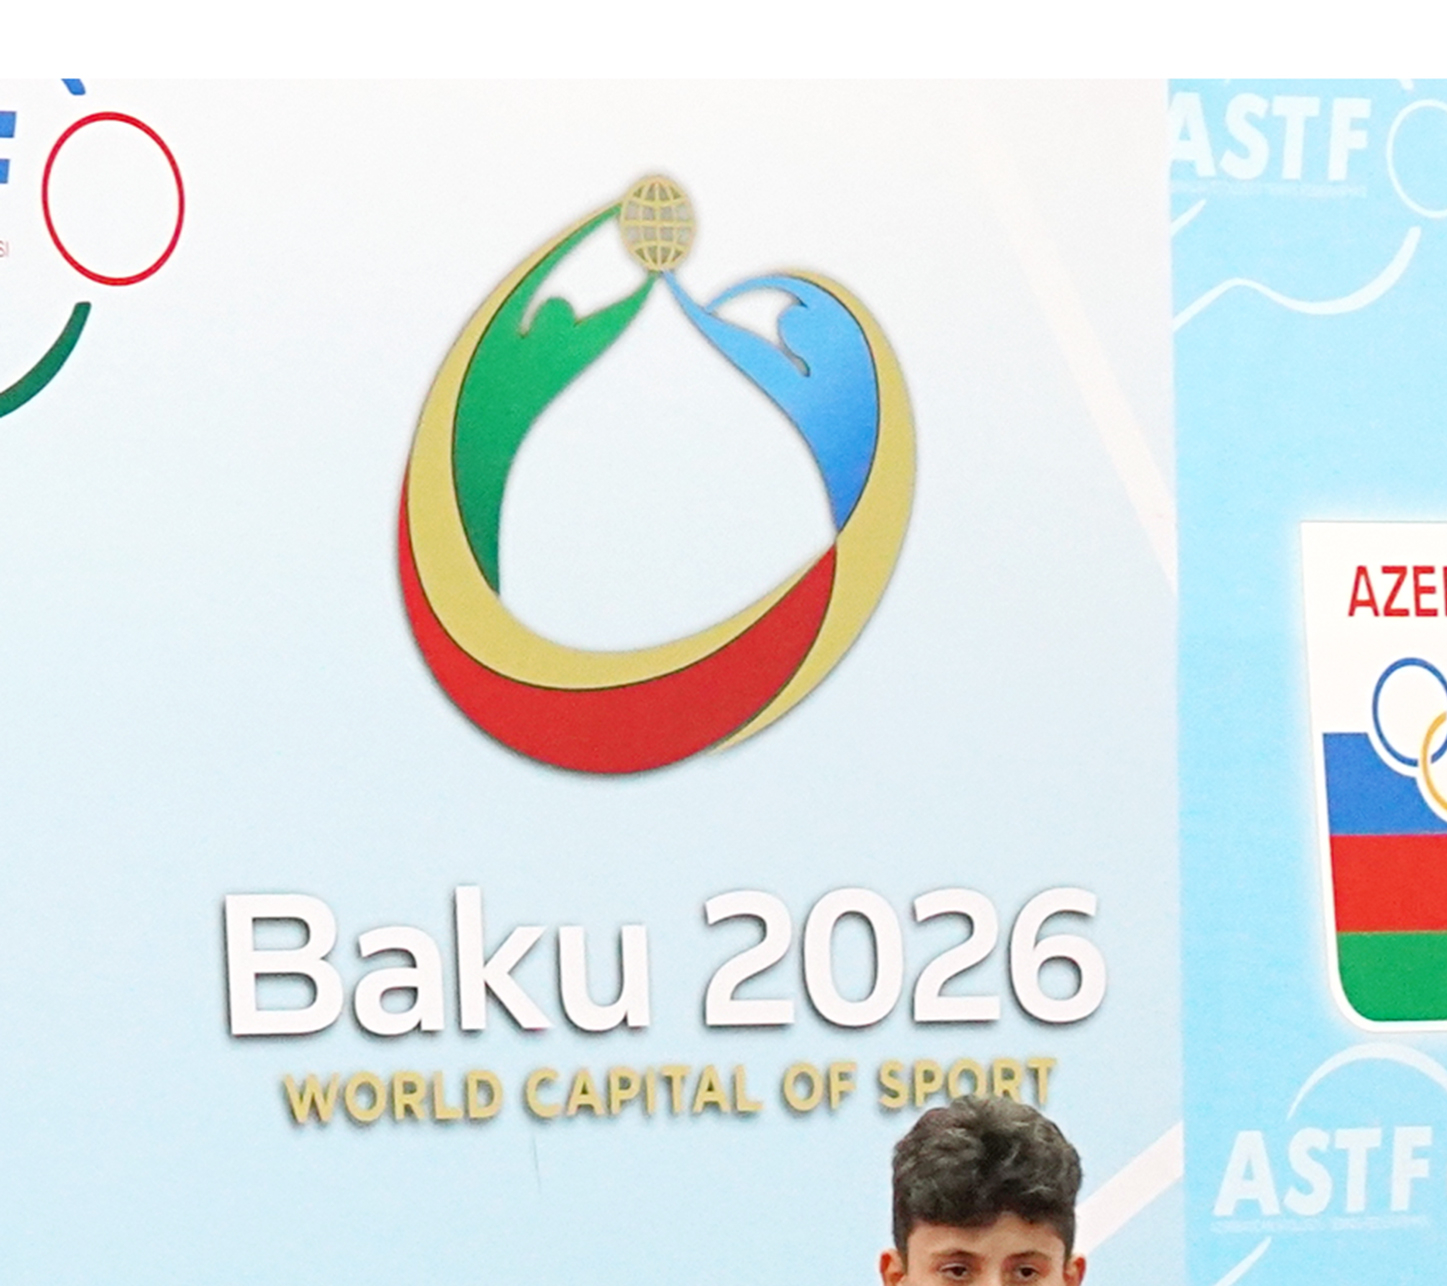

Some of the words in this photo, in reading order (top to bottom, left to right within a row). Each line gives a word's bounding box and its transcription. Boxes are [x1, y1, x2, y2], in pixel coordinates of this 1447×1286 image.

[1168, 92, 1371, 181] ASTF
[225, 886, 650, 1036] Baku
[705, 887, 1107, 1028] 2026
[283, 1070, 501, 1124] WORLD
[526, 1064, 763, 1118] CAPITAL
[783, 1061, 858, 1112] OF
[879, 1057, 1057, 1110] SPORT
[1212, 1125, 1433, 1217] ASTF
